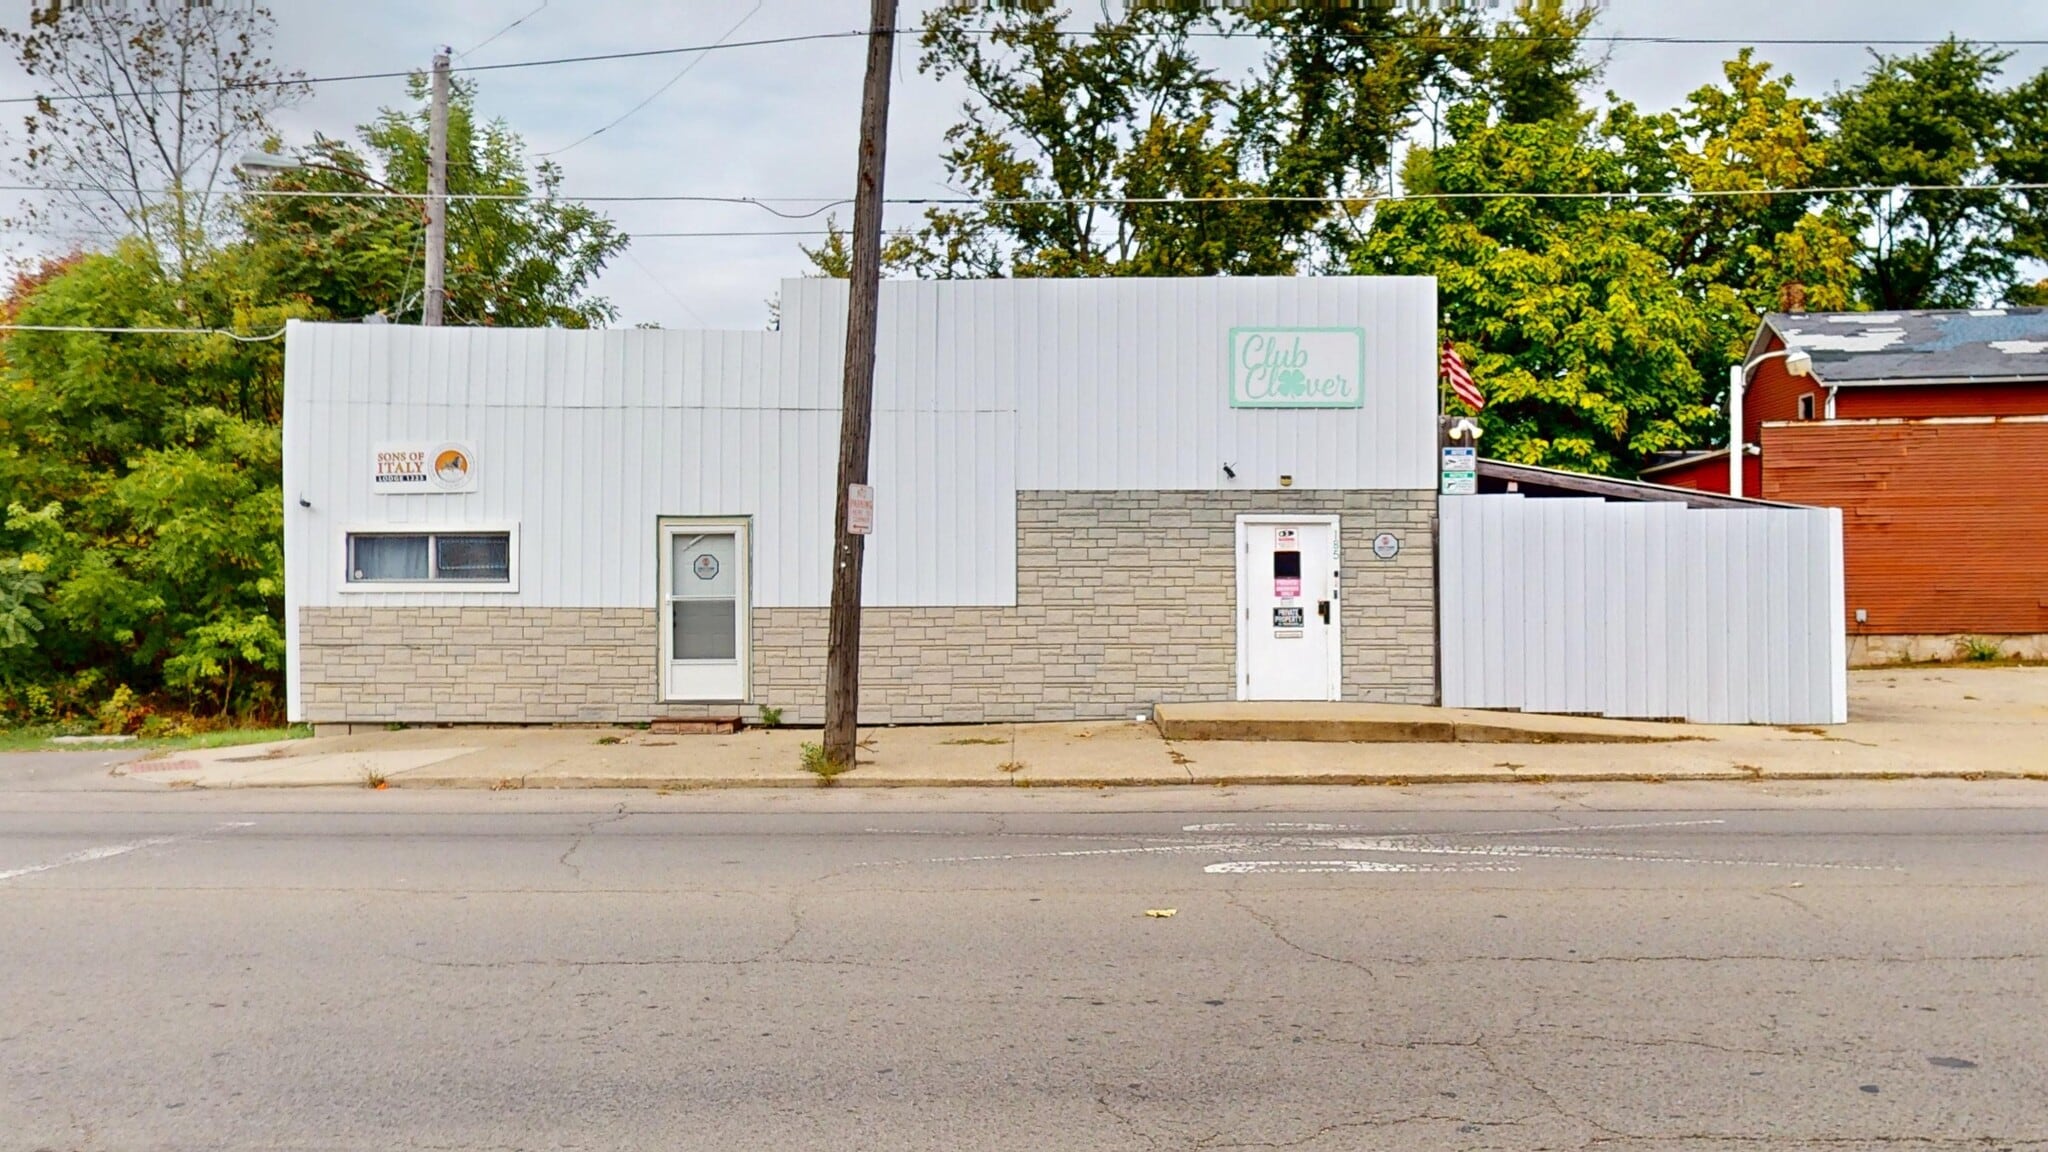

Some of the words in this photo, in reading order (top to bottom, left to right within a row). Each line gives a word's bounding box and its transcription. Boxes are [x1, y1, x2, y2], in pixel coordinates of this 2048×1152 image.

[1242, 334, 1309, 371] Club
[377, 452, 406, 462] SONS
[409, 452, 425, 461] OF
[377, 462, 424, 474] ITALY
